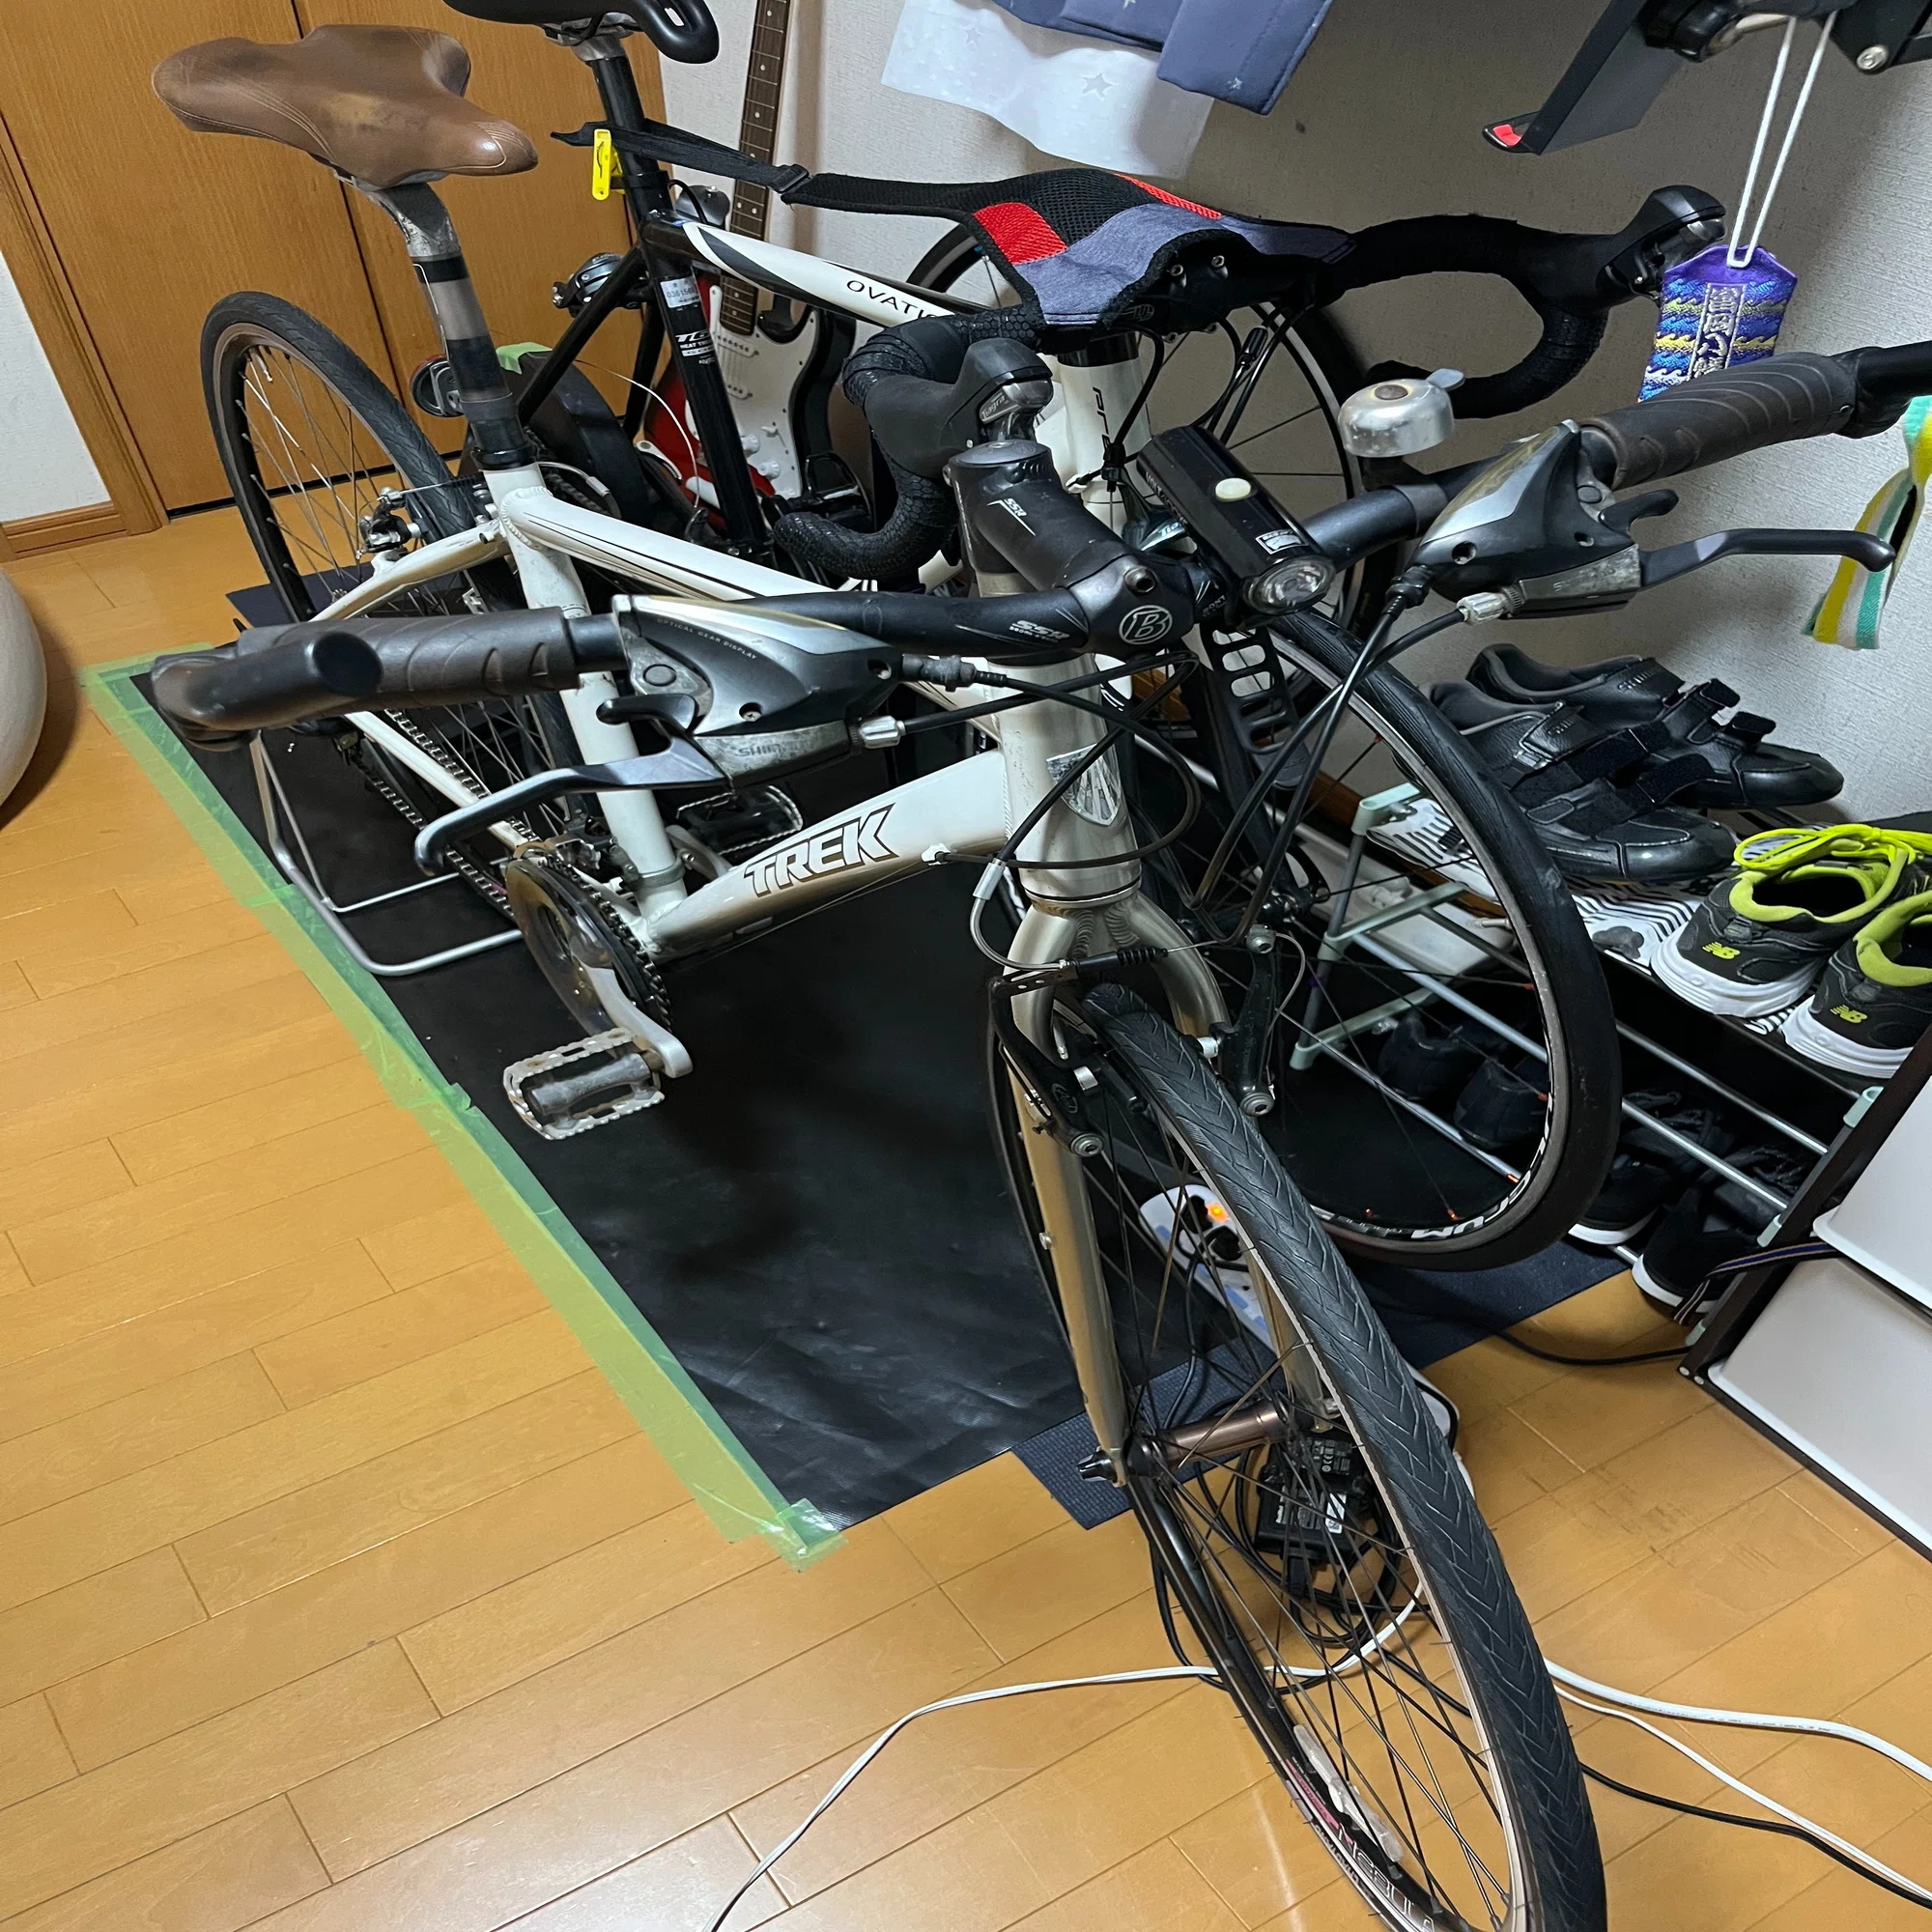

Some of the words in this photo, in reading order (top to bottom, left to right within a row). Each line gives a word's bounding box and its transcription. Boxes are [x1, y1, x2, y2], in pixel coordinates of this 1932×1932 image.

[846, 280, 936, 320] OVATI
[657, 618, 694, 634] OPTICAL
[697, 630, 722, 643] GEAR
[724, 640, 758, 660] DISPLAY
[743, 802, 900, 898] TREK
